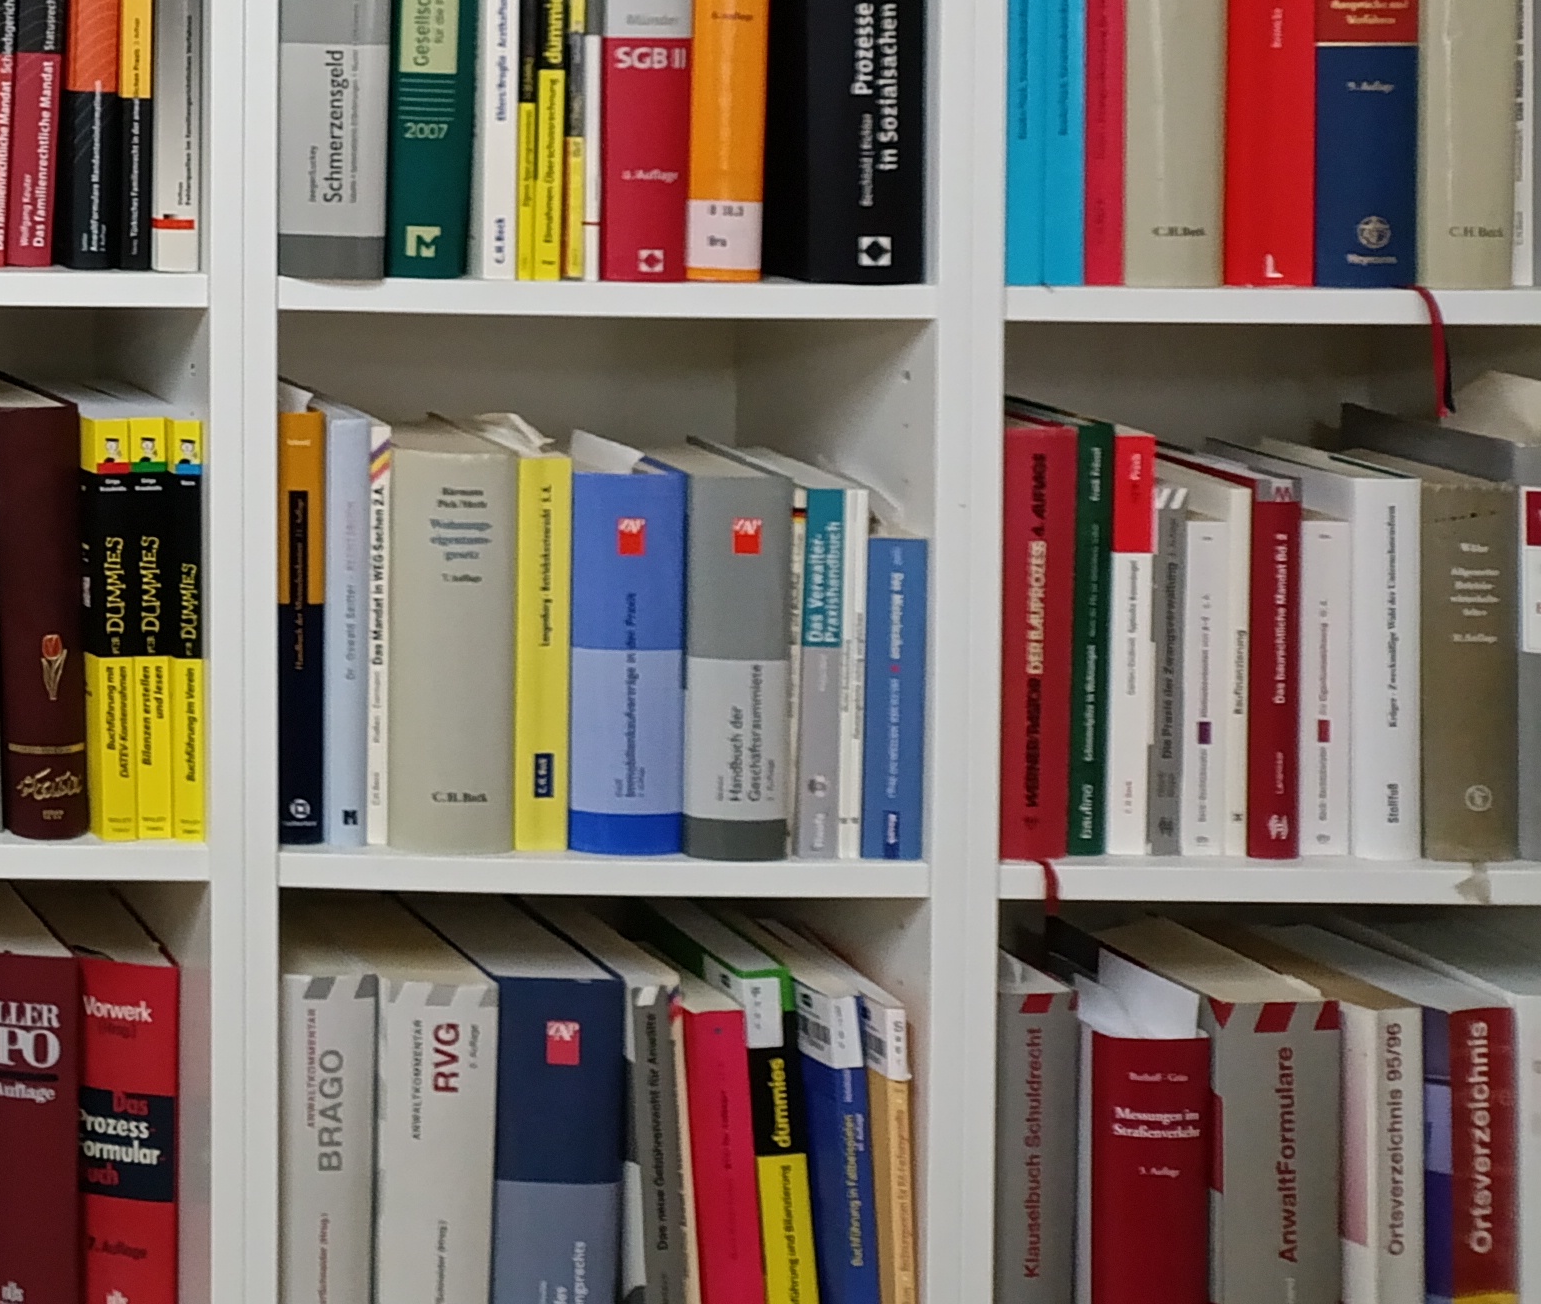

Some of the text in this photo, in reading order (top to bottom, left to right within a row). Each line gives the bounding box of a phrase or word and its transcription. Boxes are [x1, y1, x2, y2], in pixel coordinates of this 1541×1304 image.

[615, 47, 685, 68] SGB II
[850, 2, 874, 96] Prozesse
[875, 3, 899, 171] in Sozialsachen
[324, 50, 349, 204] Schmerzensgeld
[404, 122, 448, 140] 2007
[104, 537, 126, 634] DUMMIES
[139, 536, 162, 633] DUMMIES
[179, 564, 198, 638] DUMMIES
[83, 995, 152, 1024] Vorwerk
[434, 1022, 459, 1095] RVG
[771, 1058, 793, 1148] dummies
[319, 1049, 345, 1174] BRAGO
[1024, 1028, 1043, 1279] Klauselbuch Schuldrecht
[1276, 1047, 1298, 1263] AnwaltFormulare
[1388, 1023, 1404, 1256] Ortsverzeichnis 95/96
[1469, 1021, 1490, 1255] Ortsverzeichnis
